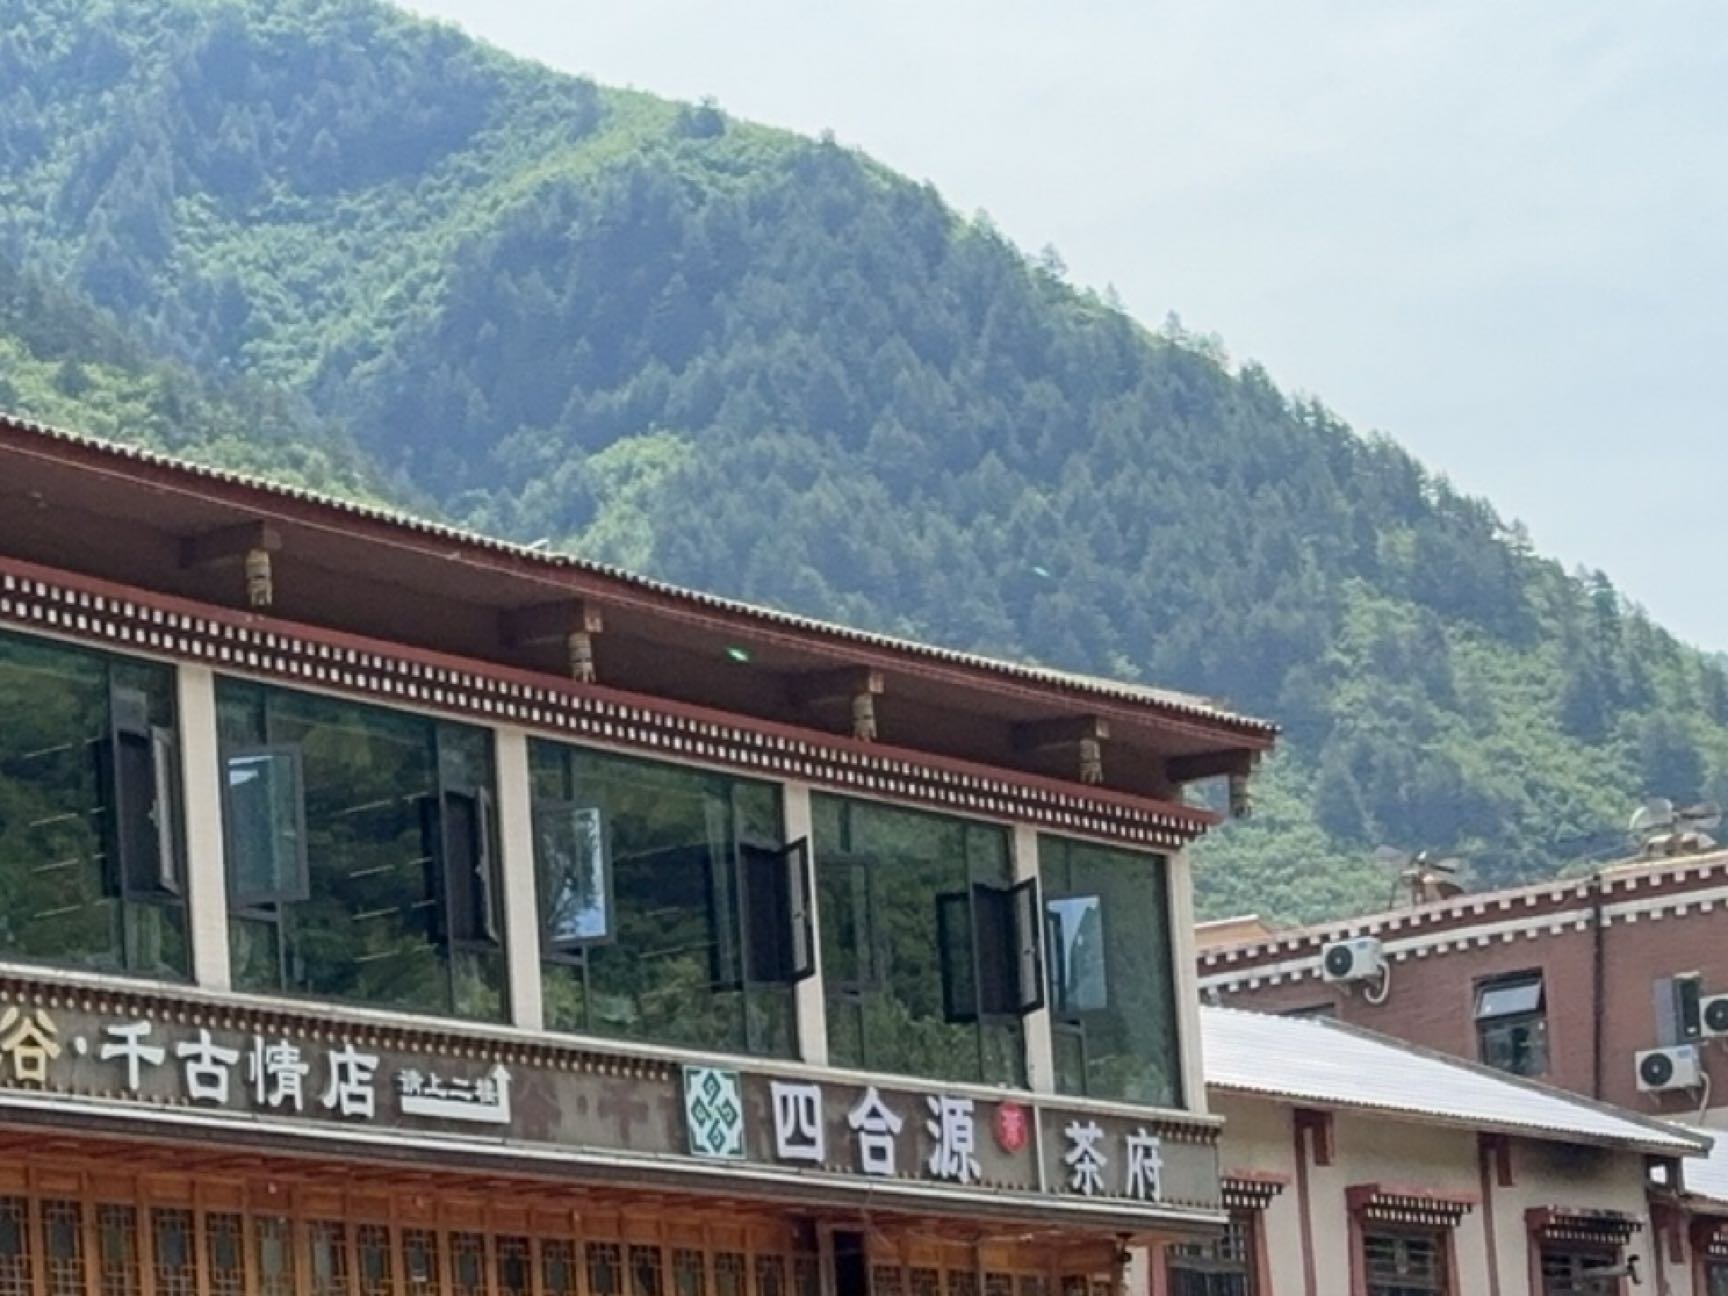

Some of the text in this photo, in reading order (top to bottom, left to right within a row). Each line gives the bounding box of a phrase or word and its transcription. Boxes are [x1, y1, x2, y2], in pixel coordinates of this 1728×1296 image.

[771, 1081, 981, 1183] 四合源
[1064, 1120, 1164, 1201] 茶府
